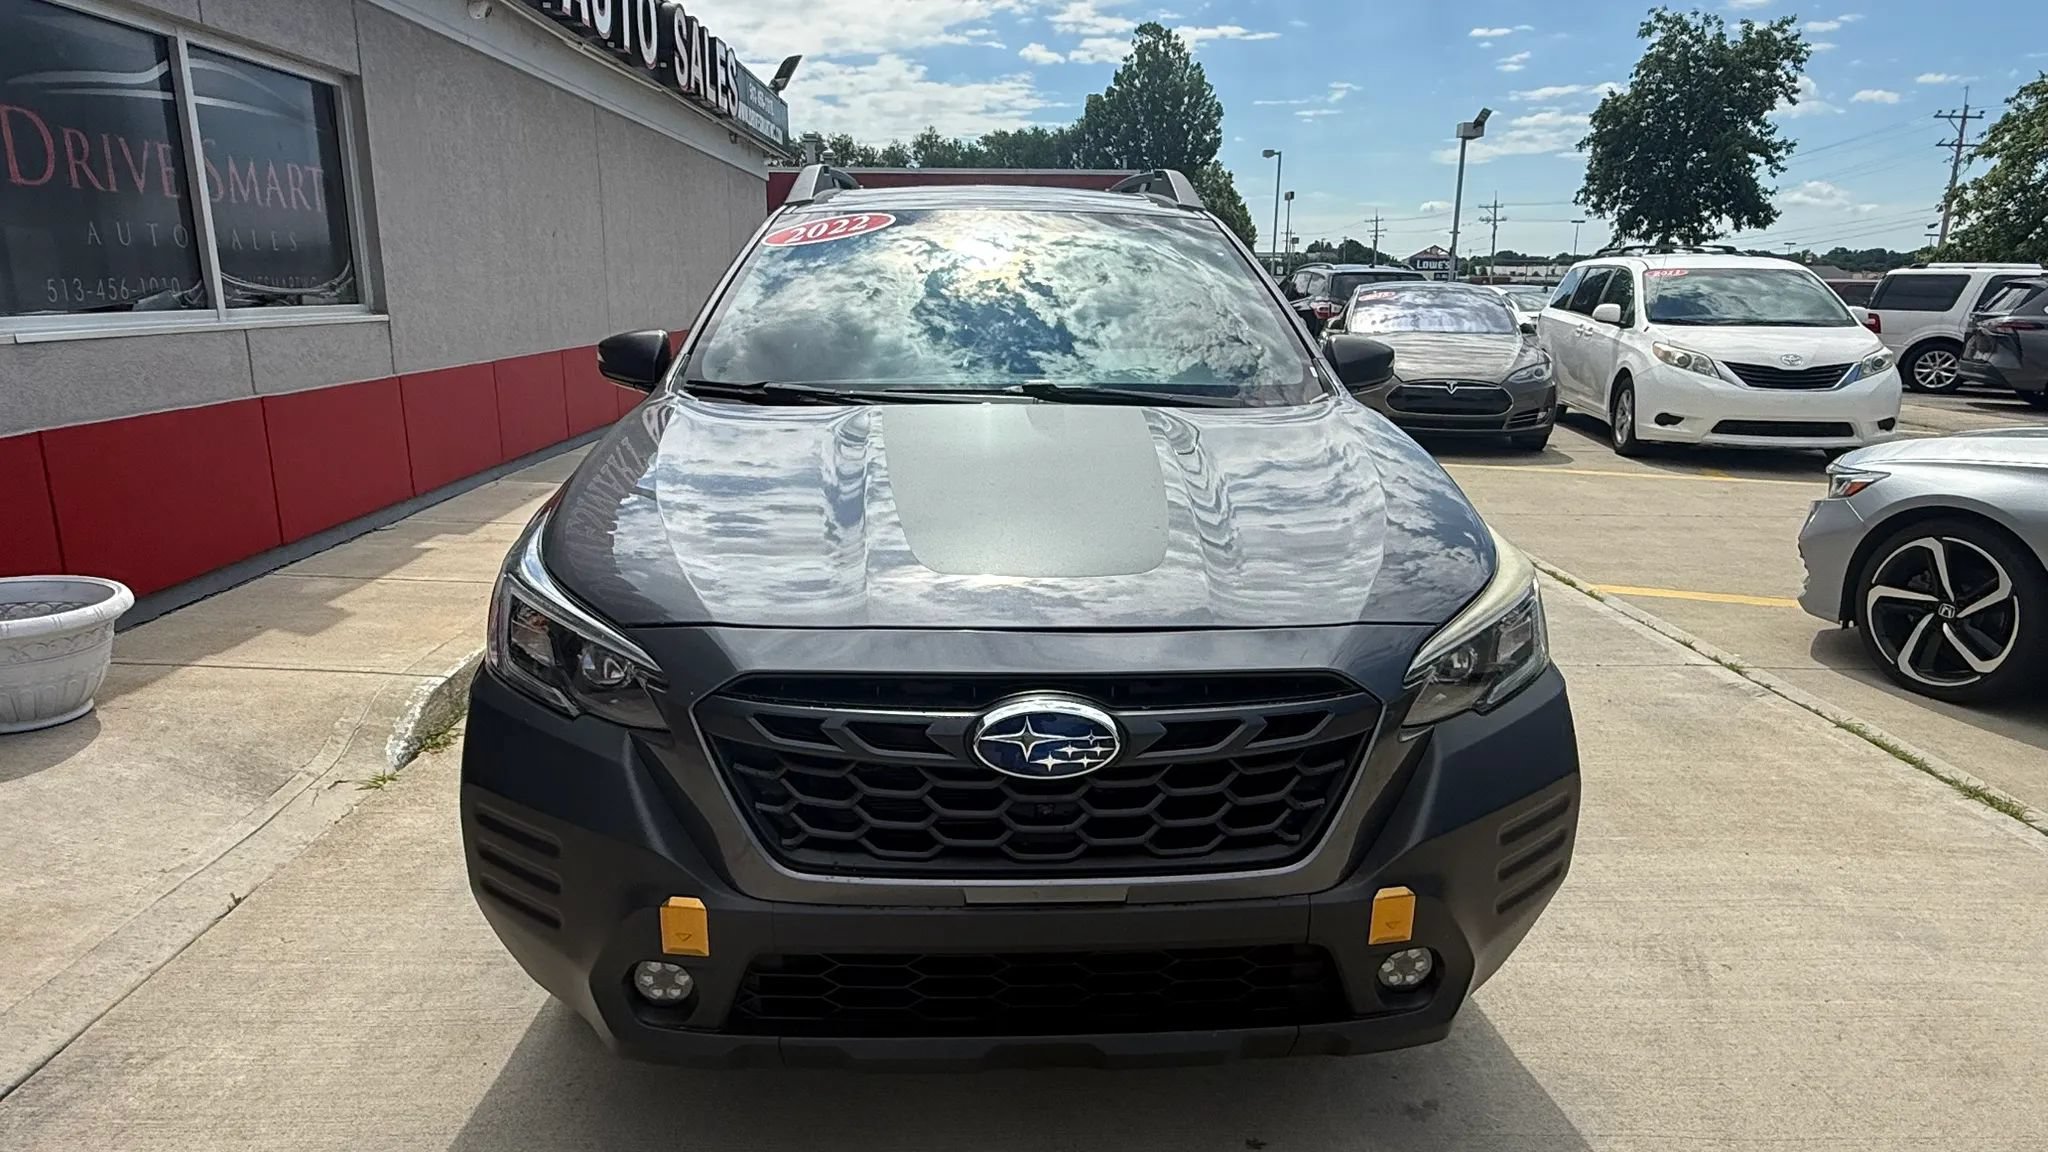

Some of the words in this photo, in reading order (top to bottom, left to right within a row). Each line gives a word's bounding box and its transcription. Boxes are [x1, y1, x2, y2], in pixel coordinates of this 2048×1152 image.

[674, 6, 739, 117] SALES
[0, 104, 180, 198] DRIVE
[203, 138, 324, 212] SMART
[87, 221, 190, 249] AUTO
[231, 229, 298, 252] ALES
[786, 215, 870, 243] 2022
